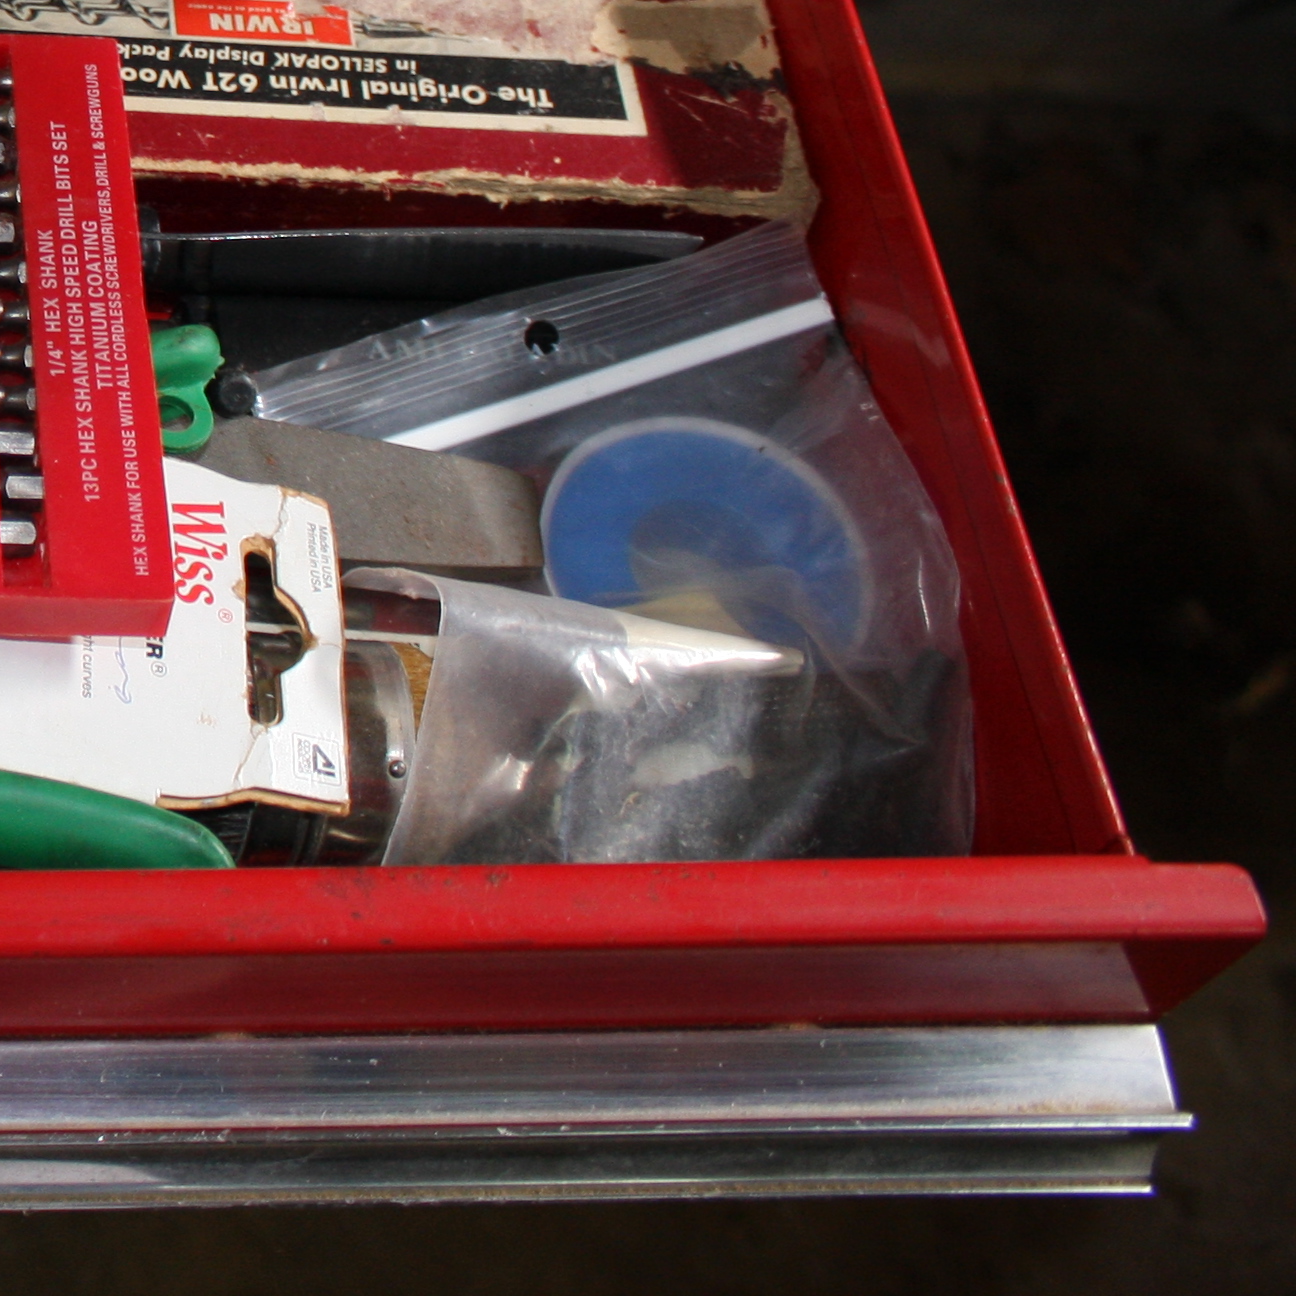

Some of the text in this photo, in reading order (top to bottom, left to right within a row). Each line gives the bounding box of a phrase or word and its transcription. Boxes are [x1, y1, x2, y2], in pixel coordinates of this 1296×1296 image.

[209, 11, 314, 35] IRWIN
[179, 42, 265, 67] Display
[275, 53, 388, 74] SELLOPAK
[395, 59, 418, 75] in
[120, 68, 555, 109] The Original Irwin 62T Woo
[36, 228, 67, 377] 1/4" HEX SHANK
[49, 120, 101, 502] 13PC HEX SHANK HIGH SPEED DRILL BITS SET
[82, 220, 114, 390] TITANIUM COATING
[84, 63, 150, 577] HEX SHANK FOR USE WITH ALL CORDLESS & SCREWGUNS
[171, 500, 228, 606] Wiss
[306, 521, 318, 559] Printed
[317, 525, 329, 554] Made
[309, 569, 321, 593] USA
[321, 566, 333, 589] USA
[79, 649, 95, 700] curves
